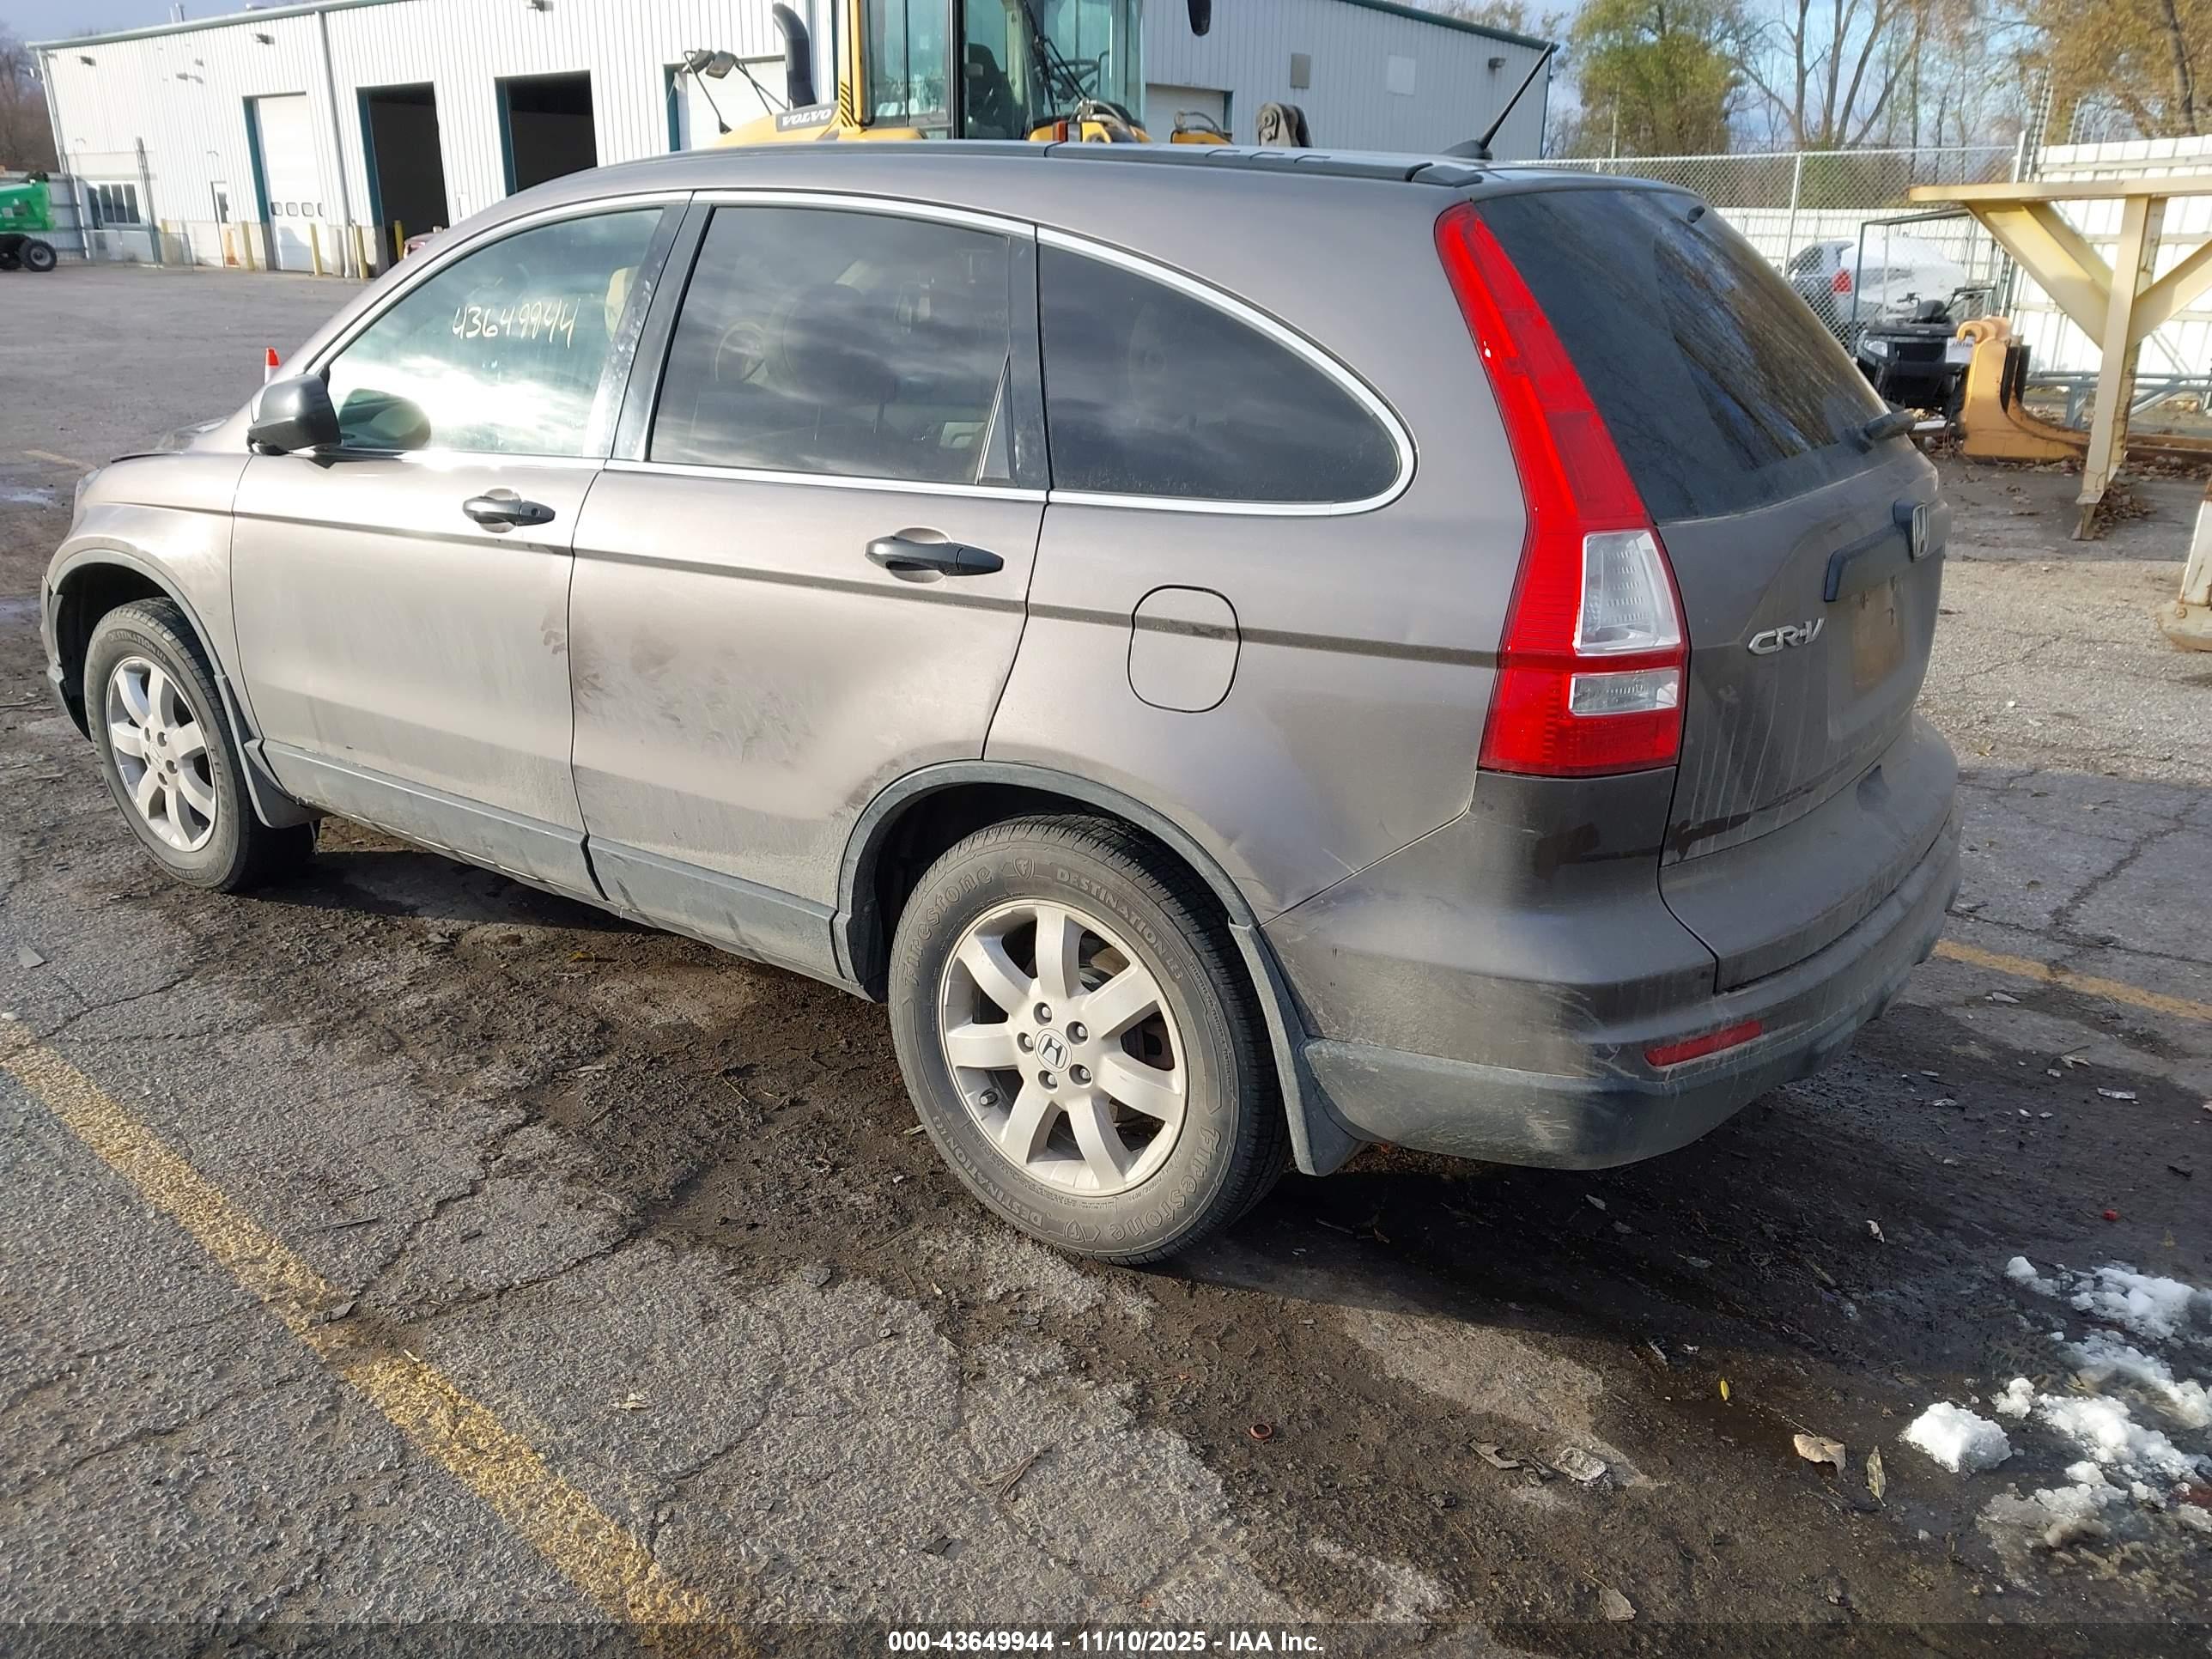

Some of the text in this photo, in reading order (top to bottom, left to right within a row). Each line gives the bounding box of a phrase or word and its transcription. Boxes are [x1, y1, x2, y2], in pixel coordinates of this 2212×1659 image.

[782, 108, 831, 126] VOLVO
[452, 297, 581, 349] 43649944
[1747, 617, 1826, 655] CR-V
[902, 865, 993, 987] Firestone
[1056, 868, 1167, 956] DESTINATION
[945, 1137, 1043, 1226] DESTINATION
[1109, 1125, 1222, 1242] Firestone
